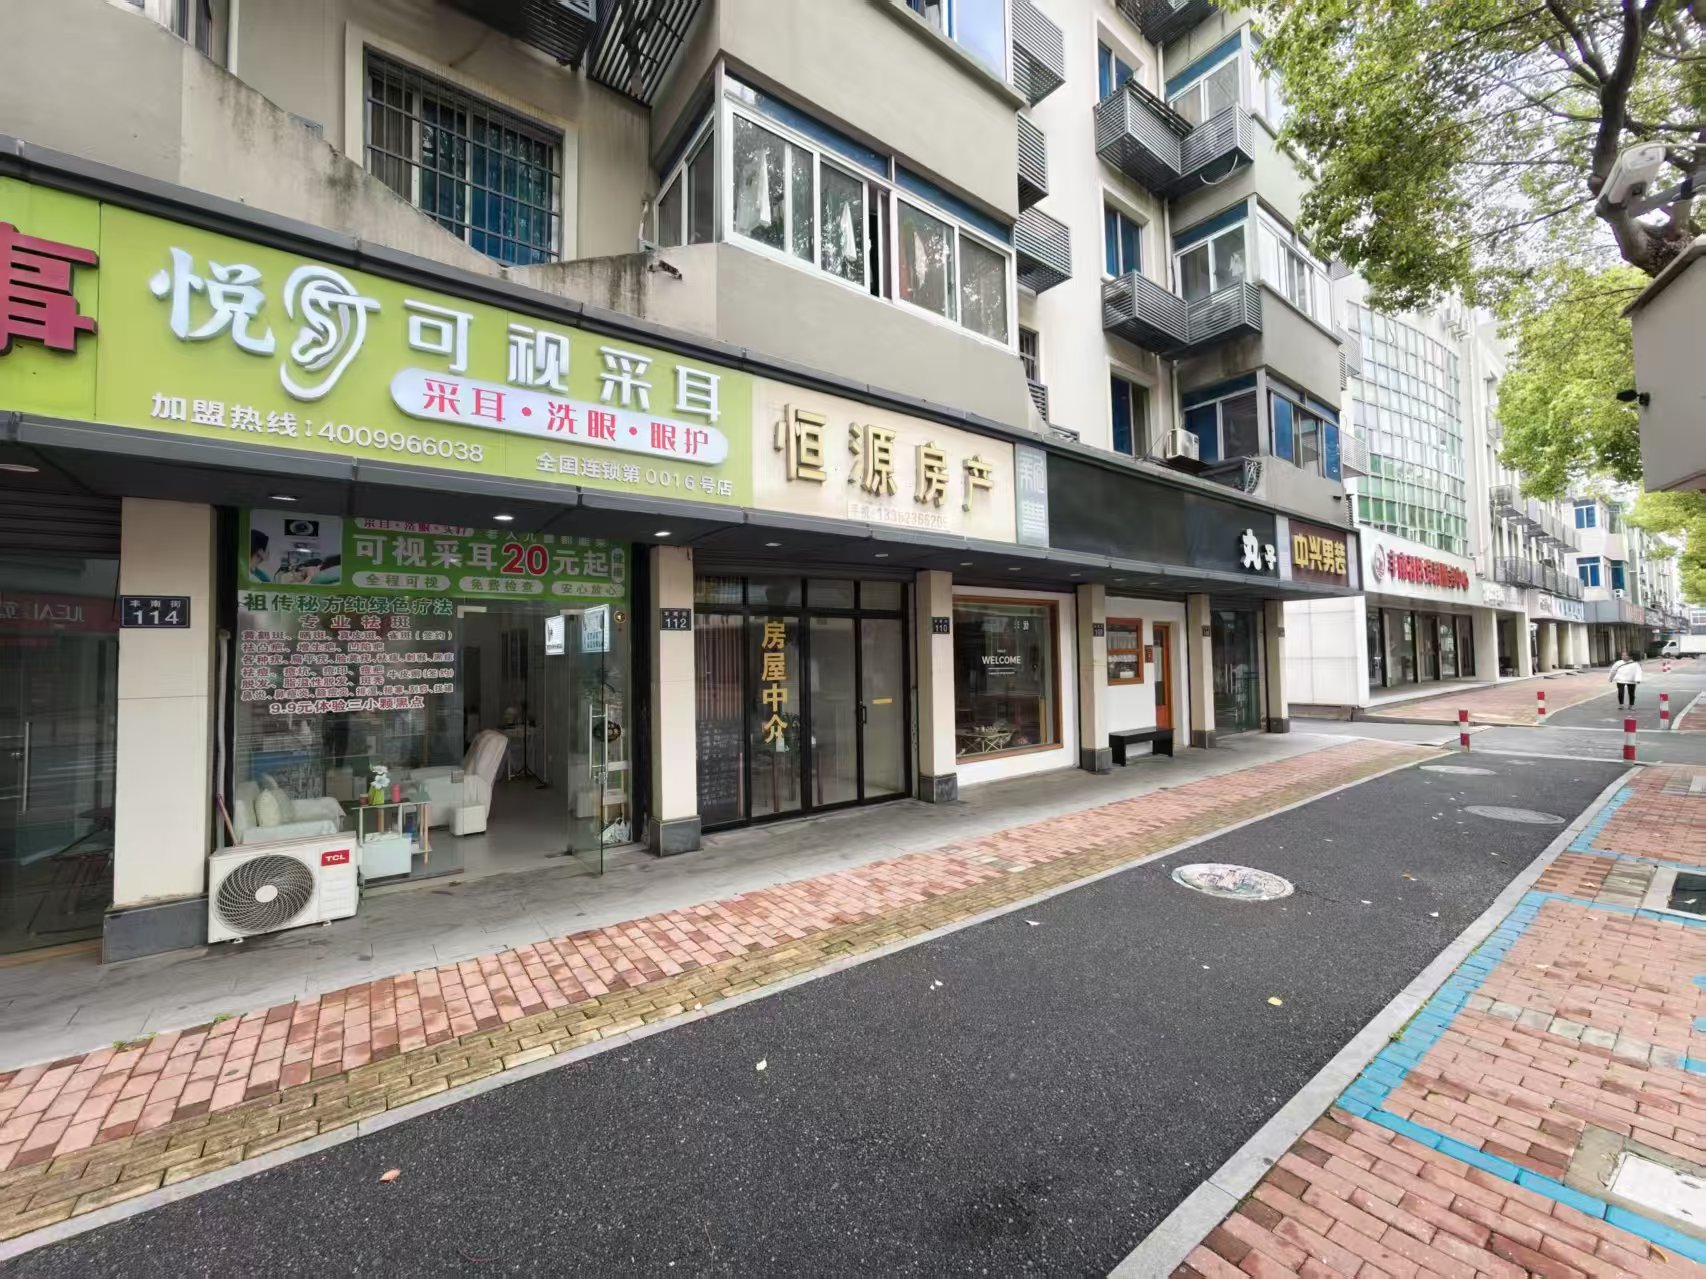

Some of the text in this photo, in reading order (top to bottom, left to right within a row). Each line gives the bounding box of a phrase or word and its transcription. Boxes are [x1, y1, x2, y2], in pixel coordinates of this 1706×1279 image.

[403, 299, 722, 423] 可视采耳
[774, 403, 994, 512] 恒源房产
[535, 453, 734, 497] 全国连锁第0016号店
[1293, 534, 1347, 575] 中兴男装
[366, 574, 439, 589] 全程可视
[471, 577, 535, 593] 免费检查
[561, 582, 617, 596] 安心放心
[243, 593, 454, 615] 祖传秘方纯绿色疗法
[132, 610, 180, 625] 114
[299, 614, 411, 629] 专业祛斑
[665, 618, 687, 628] 112
[935, 624, 948, 632] 110
[981, 655, 1021, 664] WELCOME
[761, 621, 789, 745] 房屋中介
[269, 695, 425, 715] 9.9元体验三小颗黑点
[325, 854, 346, 862] TCL
